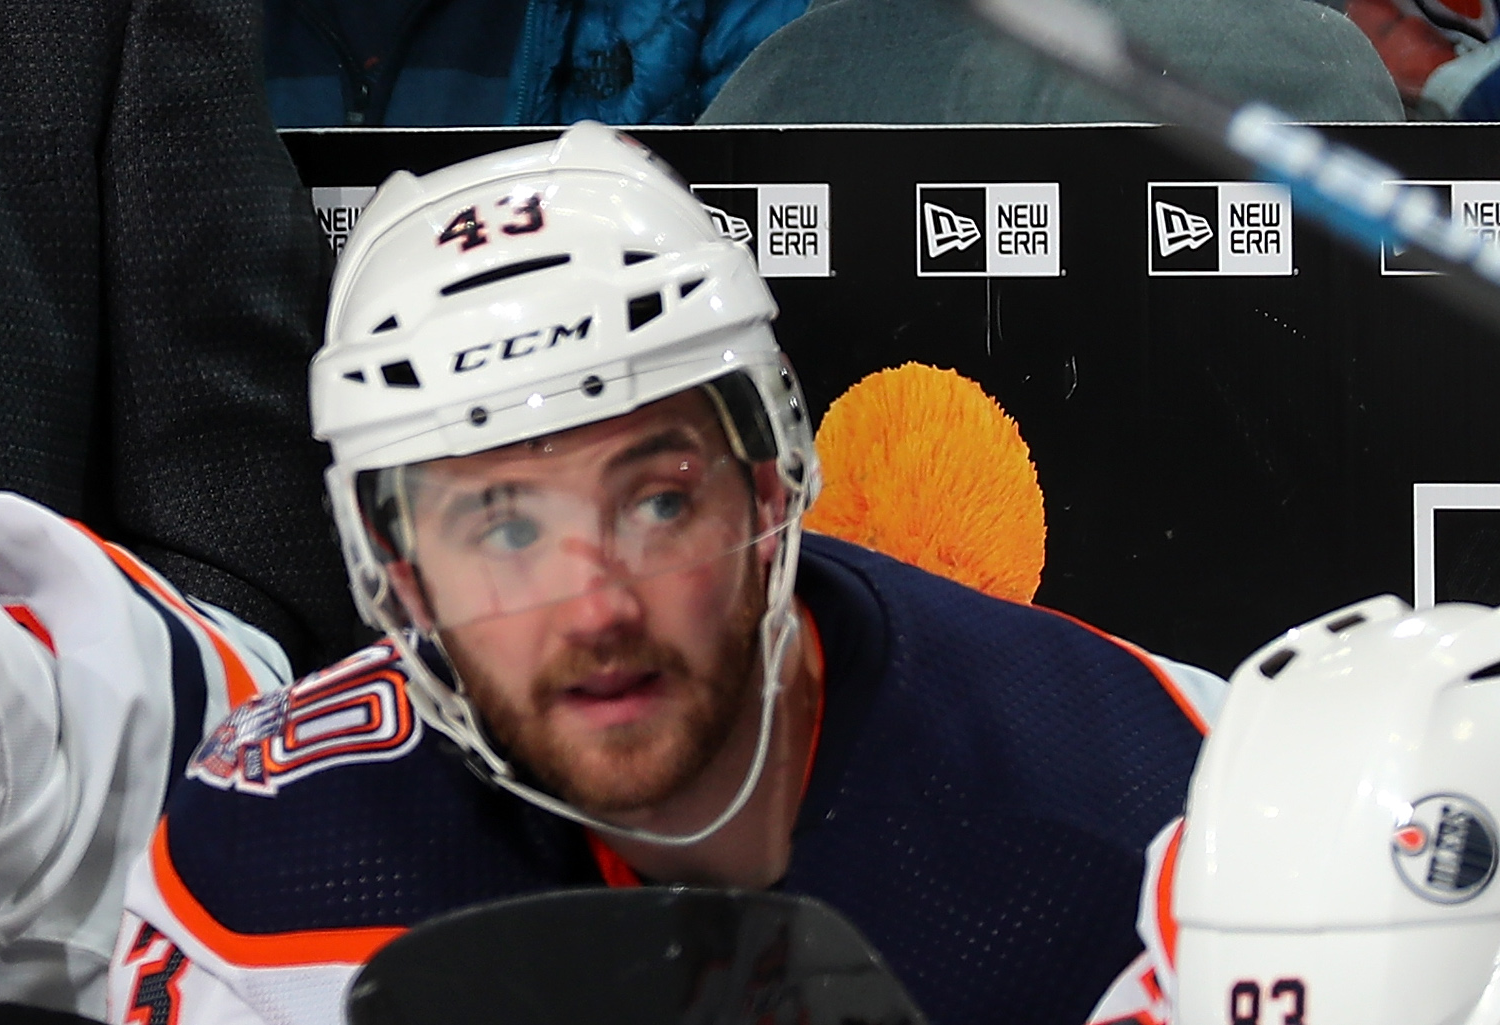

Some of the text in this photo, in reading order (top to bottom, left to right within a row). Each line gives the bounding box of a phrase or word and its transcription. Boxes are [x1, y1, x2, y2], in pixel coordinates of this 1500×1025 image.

[436, 193, 547, 253] 43
[769, 205, 818, 229] NEW
[998, 204, 1049, 228] NEW
[1229, 203, 1281, 227] NEW
[1463, 202, 1500, 226] NE
[769, 232, 818, 255] ERA
[998, 231, 1049, 255] ERA
[1229, 230, 1281, 254] ERA
[453, 317, 592, 374] CCM
